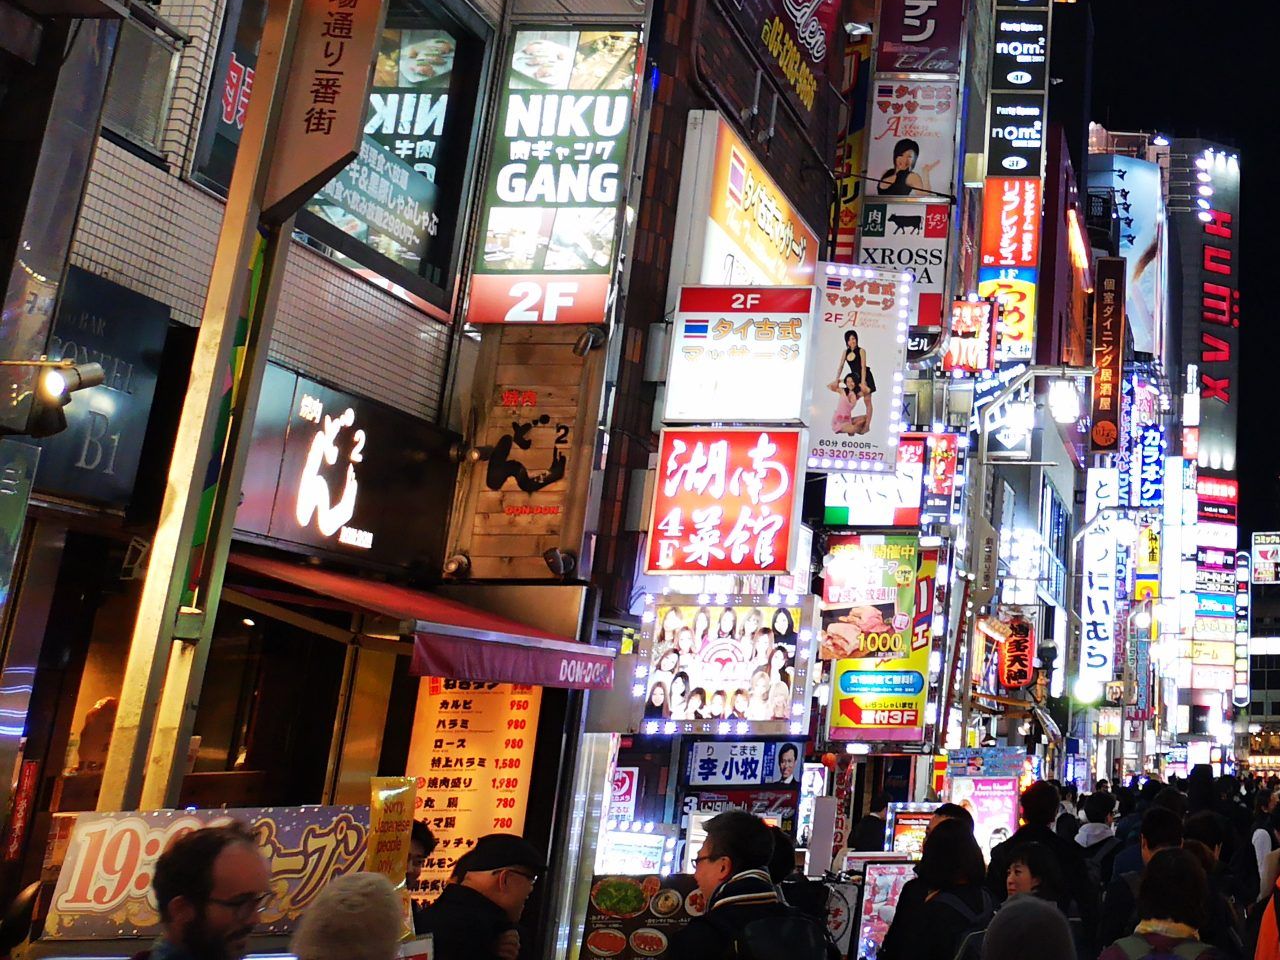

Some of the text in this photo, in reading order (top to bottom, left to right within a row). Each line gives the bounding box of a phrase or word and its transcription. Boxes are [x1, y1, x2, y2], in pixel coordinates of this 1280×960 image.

[503, 92, 630, 138] NIKU
[509, 140, 614, 161] 肉ギャング
[495, 163, 620, 203] GANG
[867, 208, 883, 222] 肉
[864, 221, 884, 231] バル
[861, 248, 943, 266] XROSS
[842, 280, 897, 297] タイ古式
[504, 281, 581, 322] 2F
[730, 293, 761, 310] 2F
[825, 292, 896, 311] マッサージ
[824, 312, 844, 324] 2F
[712, 318, 803, 341] タイ古式
[906, 339, 931, 352] ビル
[1098, 277, 1118, 411] 個室ダイニング居酒屋
[501, 389, 537, 406] 焼肉
[555, 424, 570, 445] 2
[818, 440, 839, 449] 60分
[662, 432, 790, 505] 湖南
[1142, 428, 1162, 499] カラオケ
[682, 506, 784, 568] 菜館
[1085, 570, 1112, 670] にいむら
[439, 699, 529, 711] カルビ 950
[436, 718, 526, 730] ハラミ 980
[433, 738, 524, 750] ロース 980
[706, 745, 758, 757] り こまき
[698, 757, 759, 780] 李 小牧
[495, 796, 516, 809] 780
[374, 818, 412, 835] Japanese
[492, 817, 513, 829] 780
